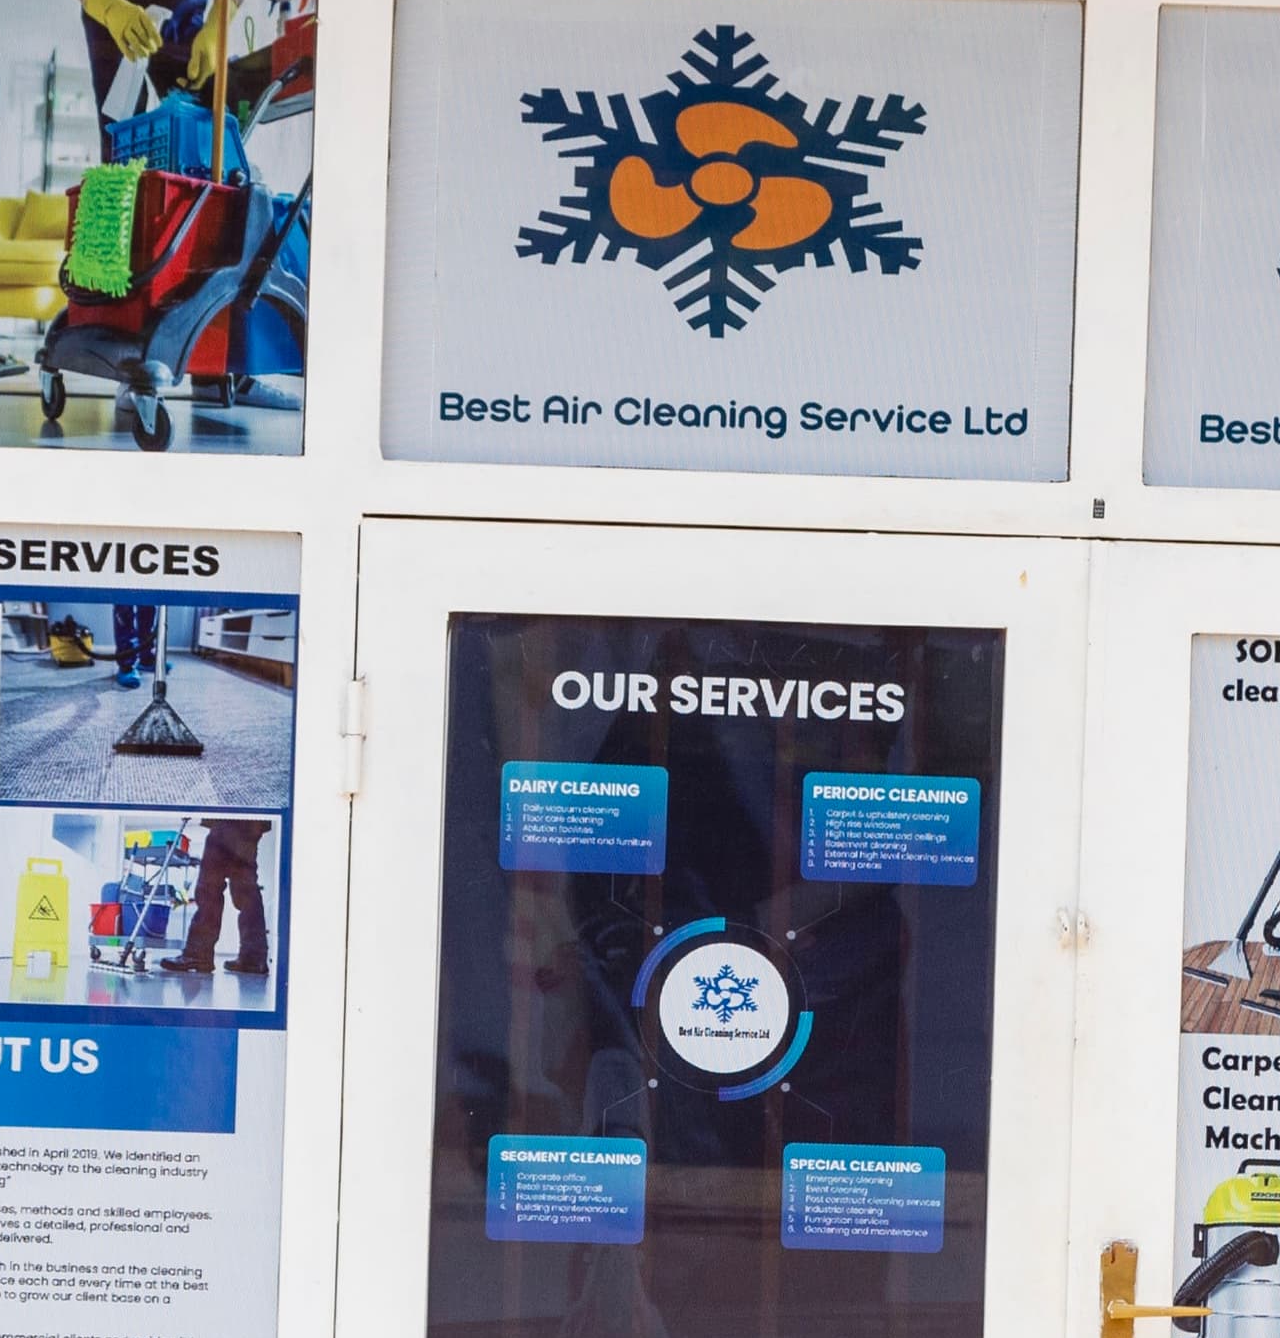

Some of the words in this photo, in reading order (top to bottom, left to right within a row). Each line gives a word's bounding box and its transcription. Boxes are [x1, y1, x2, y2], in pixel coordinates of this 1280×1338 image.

[439, 391, 531, 423] Best
[543, 395, 603, 425] Air
[614, 396, 788, 440] Cleaning
[799, 401, 952, 435] Service
[964, 406, 1028, 437] Ltd
[551, 670, 659, 713] OUR
[670, 675, 905, 722] SERVICES
[509, 778, 559, 795] DAIRY
[560, 780, 640, 797] CLEANING
[813, 785, 886, 802] PERIODIC
[888, 787, 969, 804] CLEANING
[40, 1037, 99, 1075] US
[500, 1150, 568, 1163] SEGMENT
[569, 1151, 642, 1166] CLEANING
[789, 1158, 847, 1172] SPECIAL
[849, 1159, 922, 1174] CLEANING
